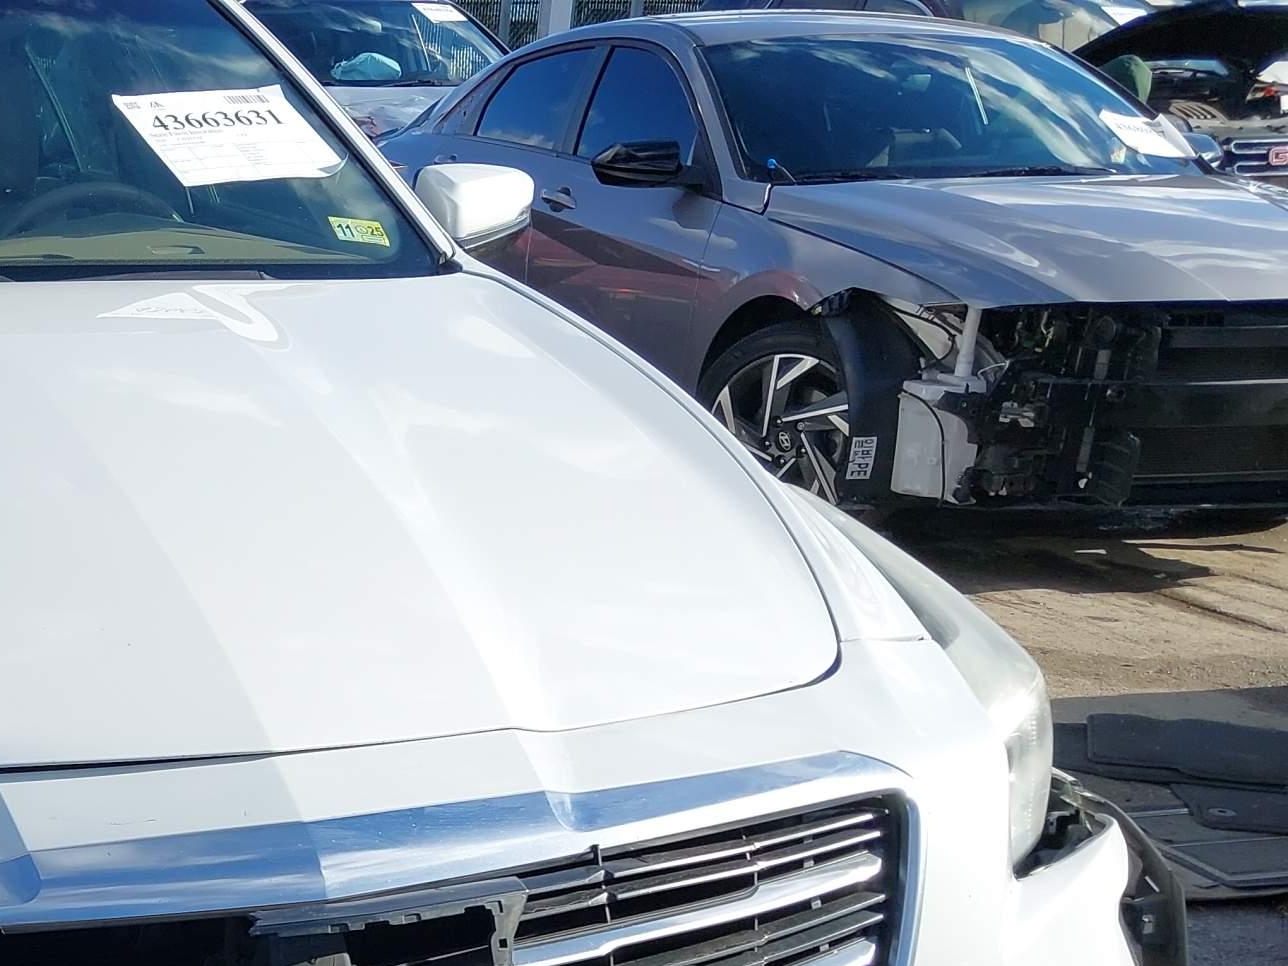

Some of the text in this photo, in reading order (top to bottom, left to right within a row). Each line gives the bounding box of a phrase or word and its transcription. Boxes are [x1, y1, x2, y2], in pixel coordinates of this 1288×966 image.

[152, 109, 285, 131] 43663631
[336, 223, 384, 238] 11 25
